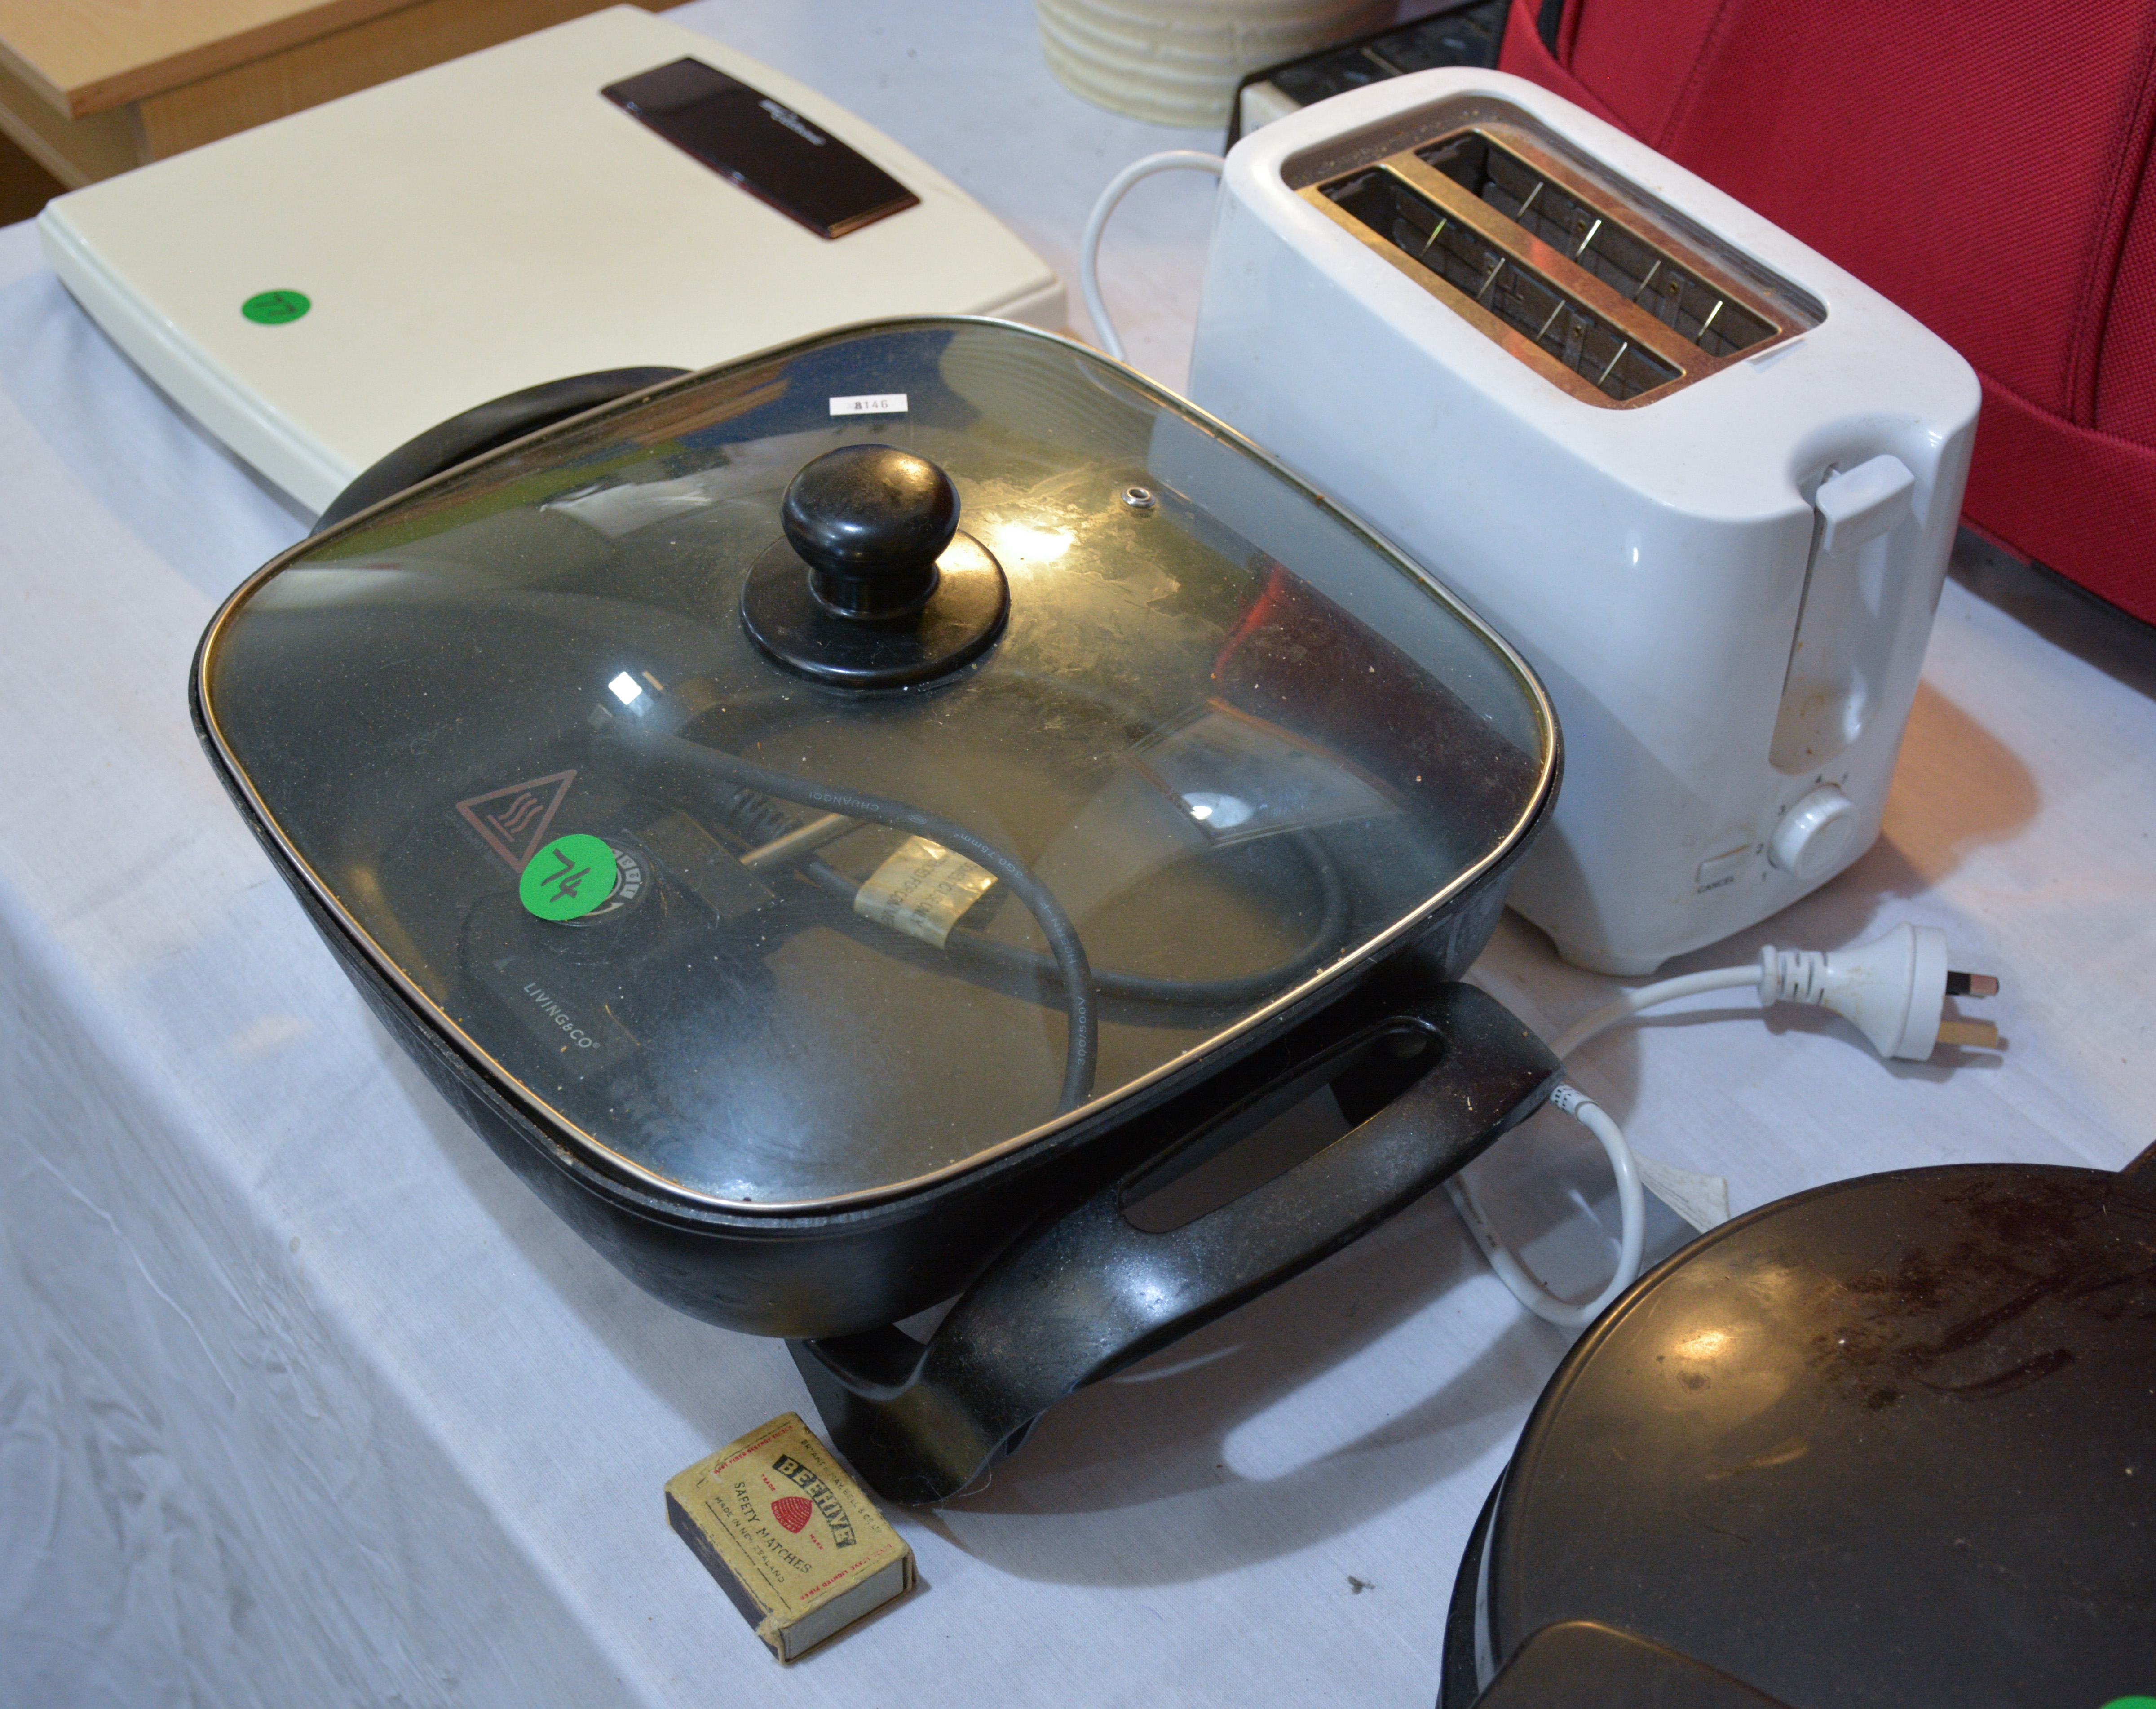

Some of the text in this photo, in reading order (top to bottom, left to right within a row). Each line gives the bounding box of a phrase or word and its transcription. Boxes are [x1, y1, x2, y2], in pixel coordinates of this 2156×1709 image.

[541, 847, 592, 903] 74
[1078, 996, 1087, 1066] 300/500V
[761, 1474, 776, 1491] TRADE
[778, 1459, 853, 1543] BEEHIVE
[715, 1496, 733, 1518] MADE
[732, 1518, 741, 1527] IN
[753, 1545, 785, 1583] ZEALAND
[734, 1481, 812, 1573] SAFETY MATCHES
